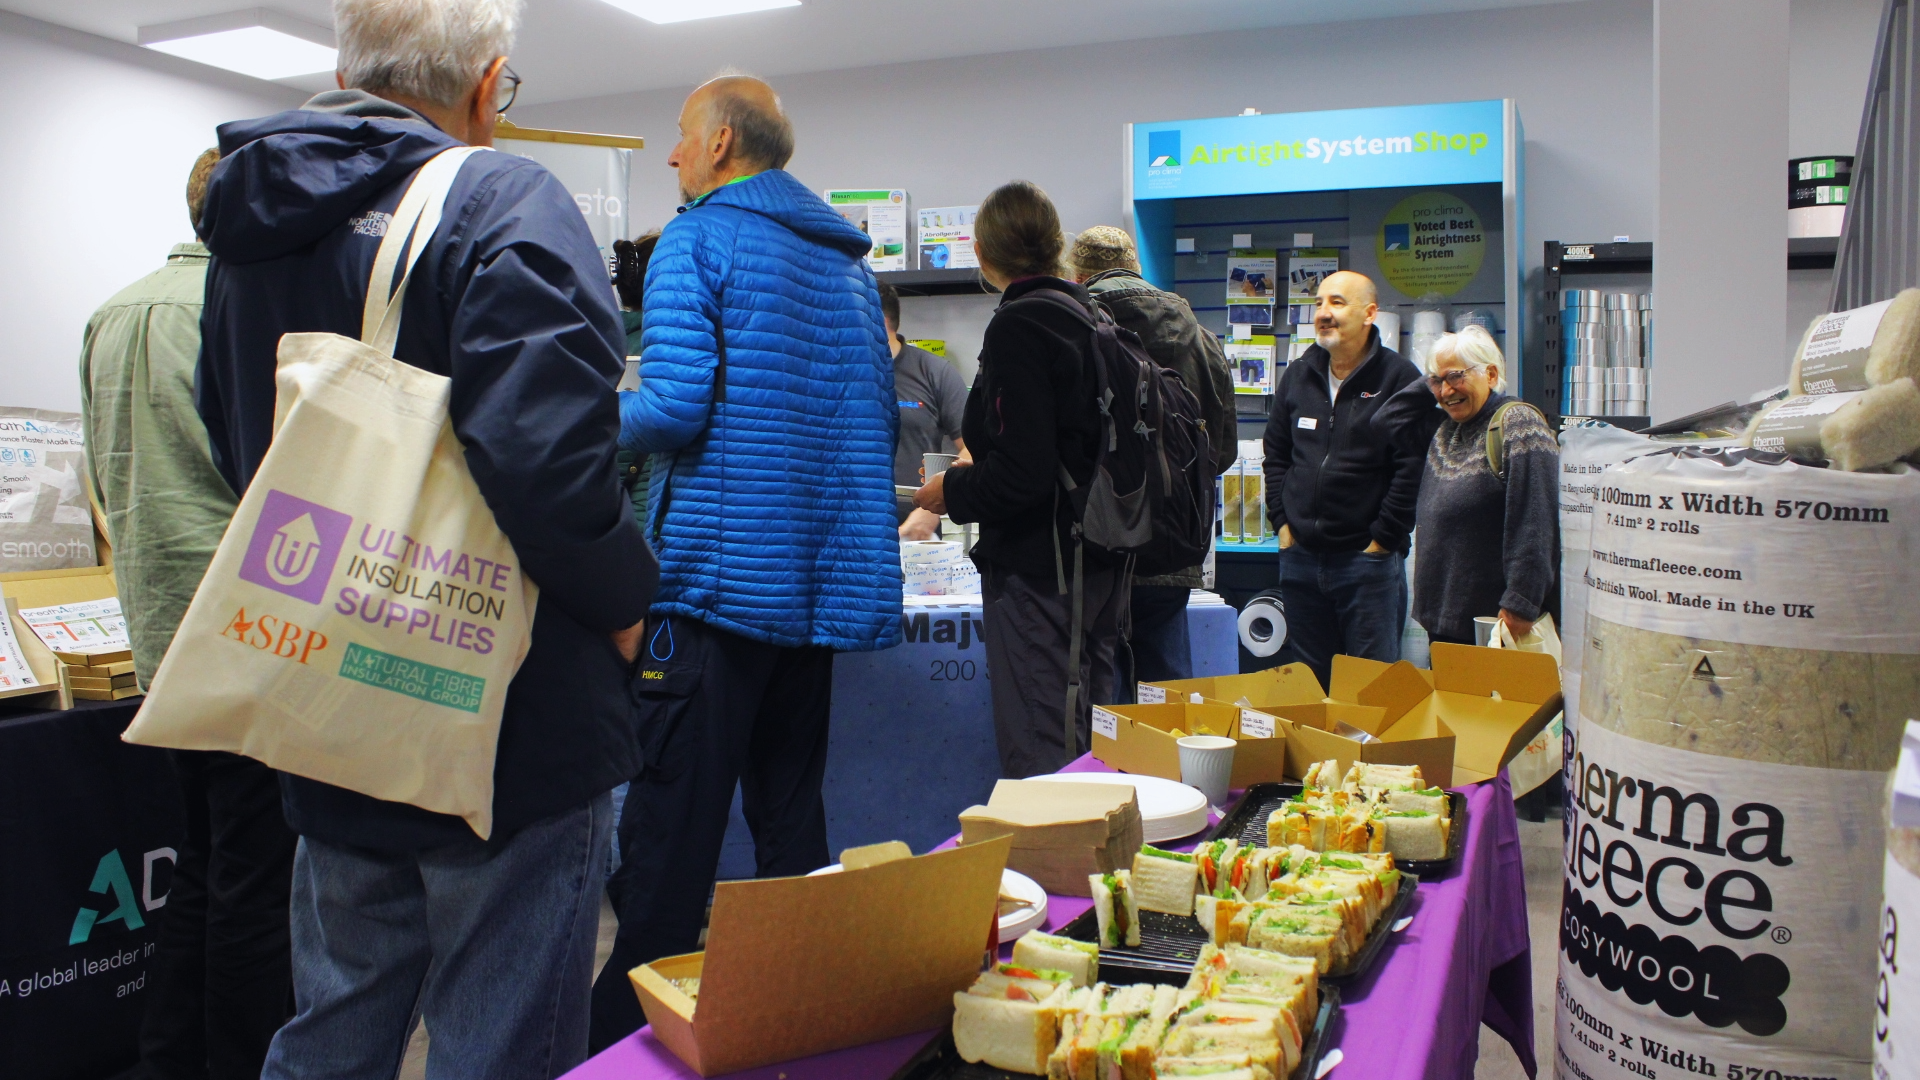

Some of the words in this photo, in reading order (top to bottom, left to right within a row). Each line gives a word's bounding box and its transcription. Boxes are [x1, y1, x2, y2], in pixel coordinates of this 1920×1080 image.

[1189, 131, 1489, 167] AirtightSystemShop
[348, 217, 381, 229] NORTH
[366, 210, 384, 221] THE
[1413, 208, 1431, 219] pro
[1434, 205, 1464, 216] clima
[353, 225, 378, 237] FACE
[1414, 221, 1446, 232] Voted
[1450, 219, 1475, 230] Best
[1414, 233, 1482, 247] Airtightness
[1566, 247, 1590, 255] 400KG
[1415, 249, 1454, 261] System
[0, 435, 20, 443] ance
[21, 436, 45, 444] Plaster.
[47, 438, 69, 446] Made
[1753, 436, 1785, 447] therma
[1563, 463, 1577, 474] Made
[1578, 464, 1587, 474] in
[1588, 463, 1603, 474] the
[1601, 487, 1652, 508] 100mm
[1658, 495, 1674, 510] x
[1681, 492, 1764, 517] Width
[1774, 499, 1890, 524] 570mm
[1646, 518, 1656, 531] 2
[1660, 520, 1700, 535] rolls
[2, 538, 92, 559] smooth
[358, 523, 512, 593] ULTIMATE
[346, 555, 506, 622] INSULATION
[1596, 577, 1625, 597] British
[1628, 585, 1662, 603] Wool.
[1666, 591, 1712, 610] Made
[1717, 597, 1736, 612] in
[1743, 600, 1776, 617] the
[1783, 603, 1815, 619] UK
[335, 587, 496, 655] SUPPLIES
[220, 606, 328, 666] ASBP
[346, 646, 429, 686] NATURAL
[431, 670, 483, 699] FIBRE
[642, 670, 665, 680] HMCG
[930, 660, 976, 681] 200
[342, 665, 426, 697] INSULATION
[429, 688, 480, 710] GROUP
[1572, 729, 1794, 868] herma
[1564, 906, 1720, 1000] COSYWOOL
[0, 979, 12, 997] A
[18, 961, 78, 998] global
[83, 948, 140, 977] leader
[143, 941, 156, 959] in
[116, 971, 146, 998] and
[1565, 996, 1614, 1041] 100mm
[1619, 1032, 1634, 1050] x
[1640, 1036, 1717, 1078] Width
[1608, 1050, 1617, 1063] 2
[1620, 1055, 1657, 1080] rolls
